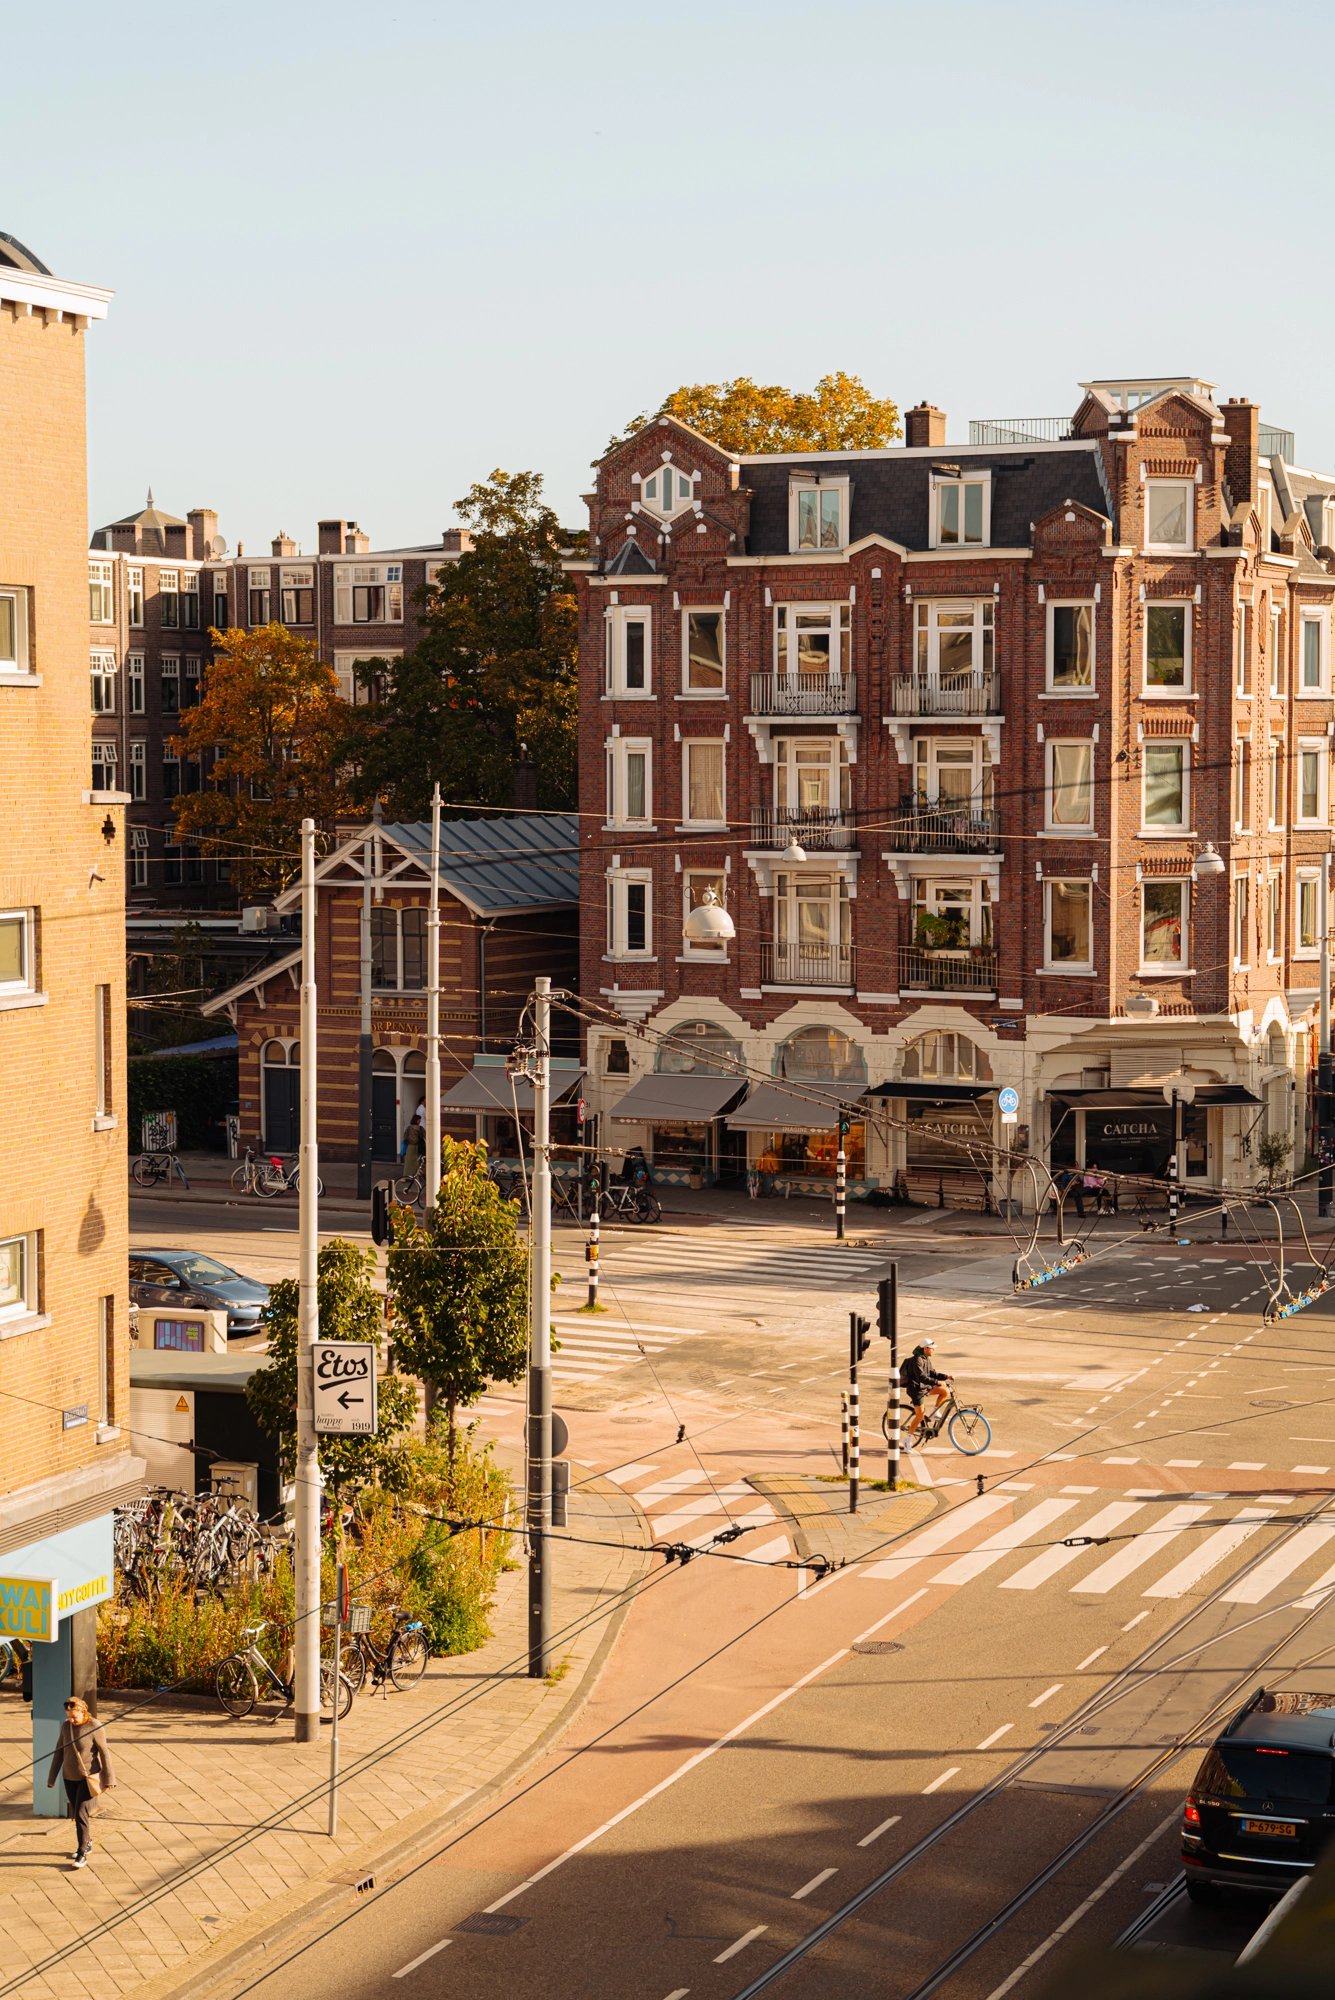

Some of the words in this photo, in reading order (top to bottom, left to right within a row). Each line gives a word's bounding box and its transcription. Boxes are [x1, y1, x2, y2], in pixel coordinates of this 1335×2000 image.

[386, 1021, 420, 1034] PENNY
[1103, 1123, 1158, 1135] CATCHA
[317, 1350, 369, 1378] Etos
[316, 1415, 343, 1426] happy
[352, 1422, 370, 1430] 1919
[76, 1575, 108, 1603] COFFEE
[1249, 1821, 1292, 1835] P-679-SG
